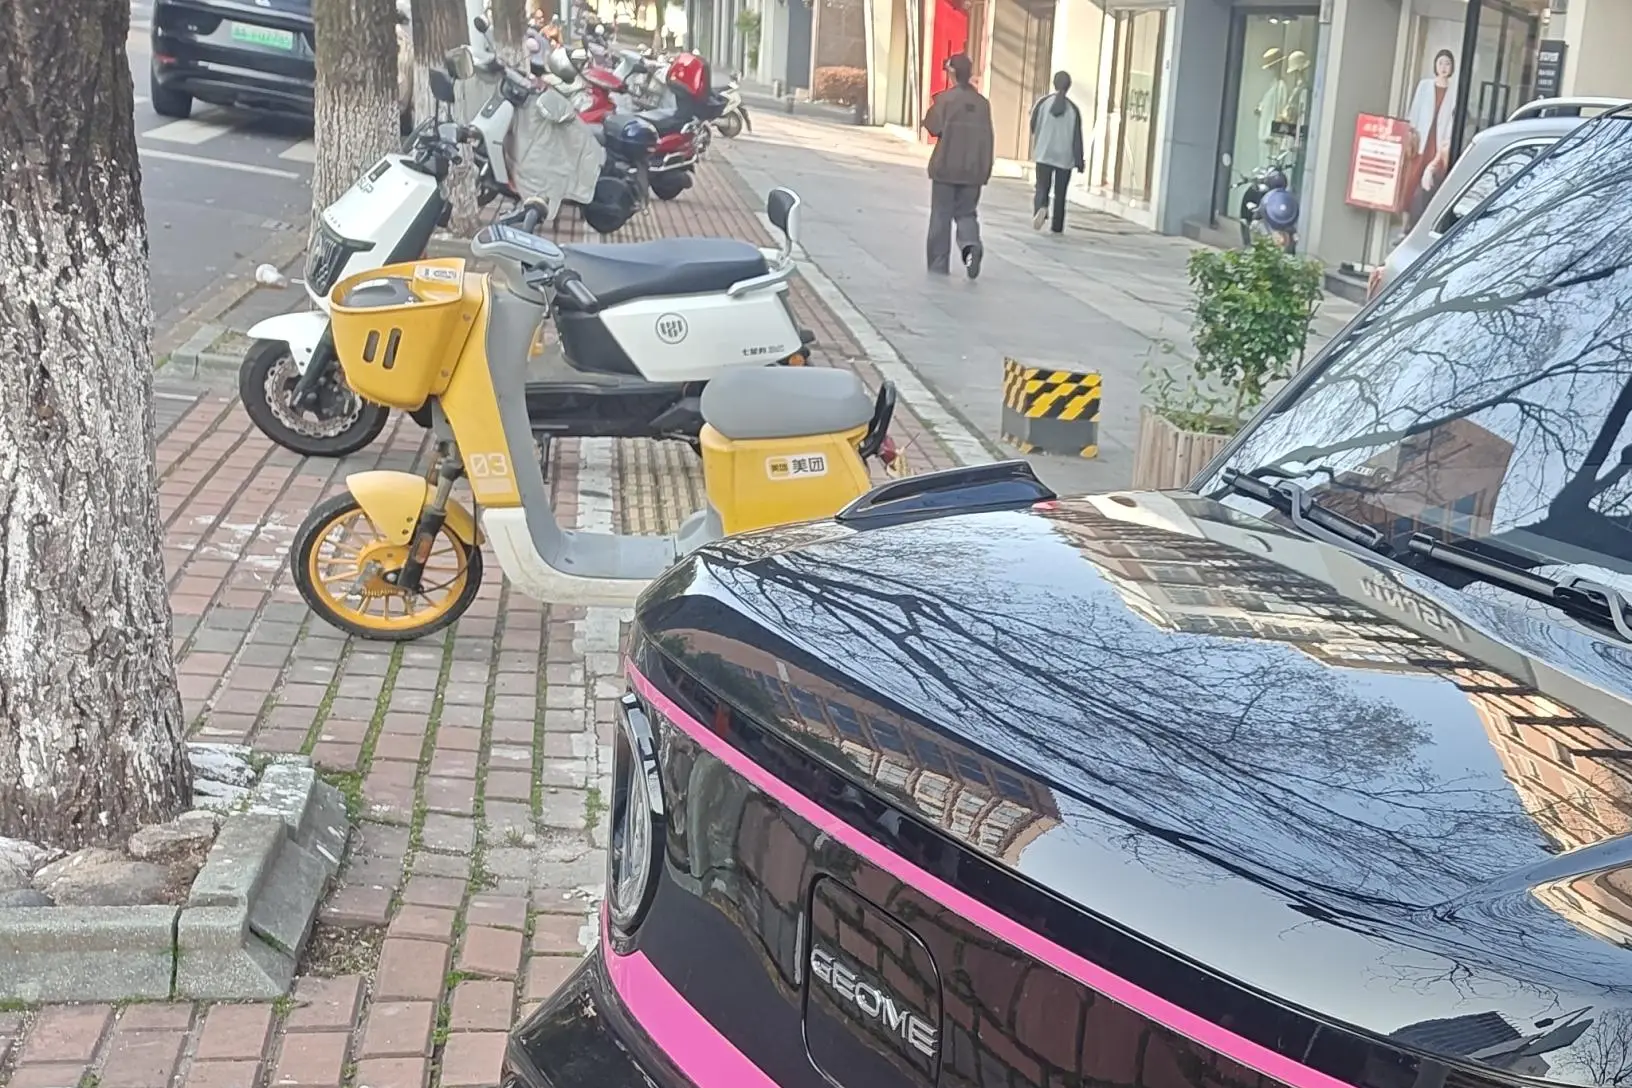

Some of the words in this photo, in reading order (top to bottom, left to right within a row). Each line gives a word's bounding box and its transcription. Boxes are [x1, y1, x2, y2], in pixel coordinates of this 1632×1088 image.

[470, 453, 508, 477] 03
[792, 457, 825, 474] 美团
[811, 944, 939, 1057] GEOME
